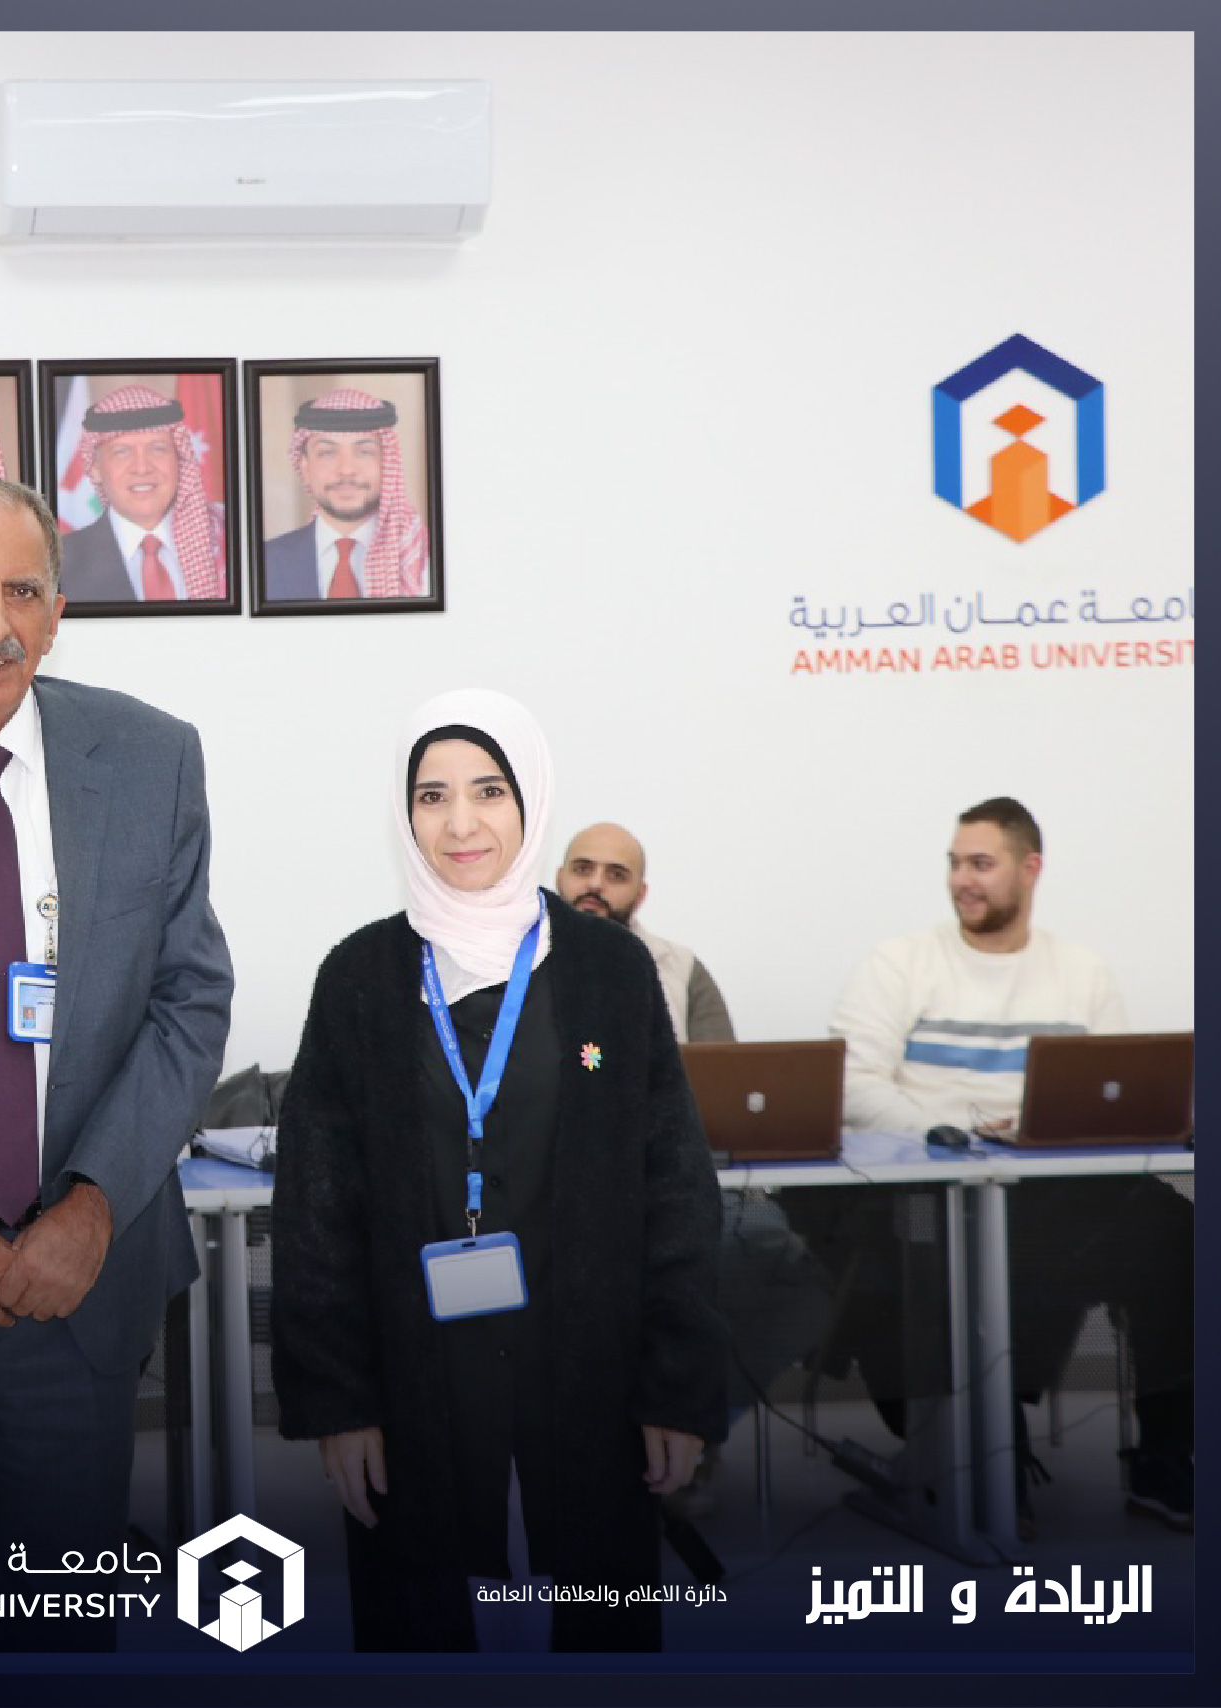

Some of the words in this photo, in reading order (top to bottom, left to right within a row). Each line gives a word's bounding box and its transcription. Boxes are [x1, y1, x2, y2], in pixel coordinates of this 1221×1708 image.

[790, 592, 935, 638] العربية
[943, 590, 1068, 634] عمان
[790, 647, 922, 674] AMMAN
[931, 643, 1020, 671] ARAB
